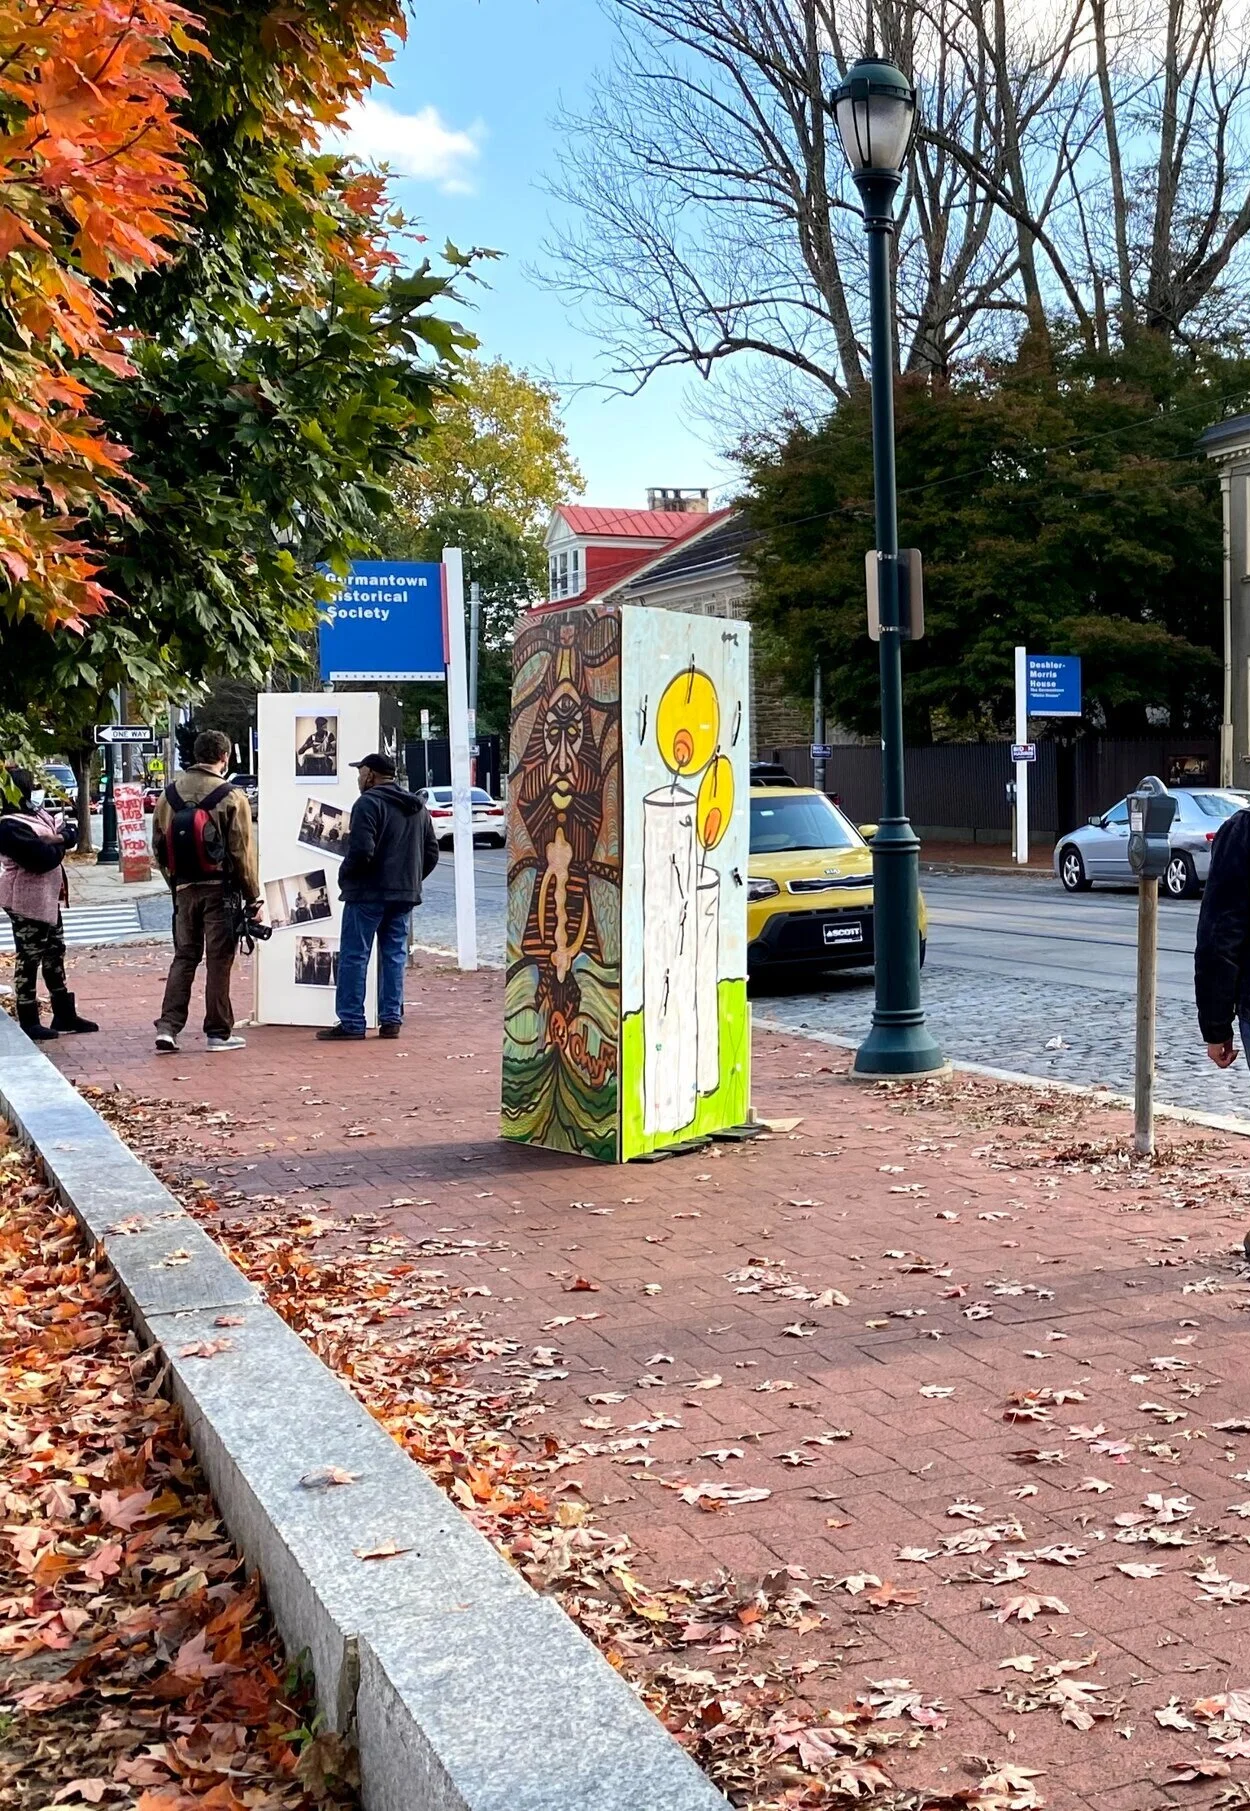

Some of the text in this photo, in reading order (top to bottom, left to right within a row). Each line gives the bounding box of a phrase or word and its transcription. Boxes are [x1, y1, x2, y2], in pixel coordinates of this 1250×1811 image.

[327, 606, 390, 621] Society
[1030, 661, 1066, 669] Deshler-
[1030, 670, 1057, 678] Morris
[1030, 680, 1056, 688] House
[122, 809, 142, 820] HUB
[119, 823, 146, 834] FREE
